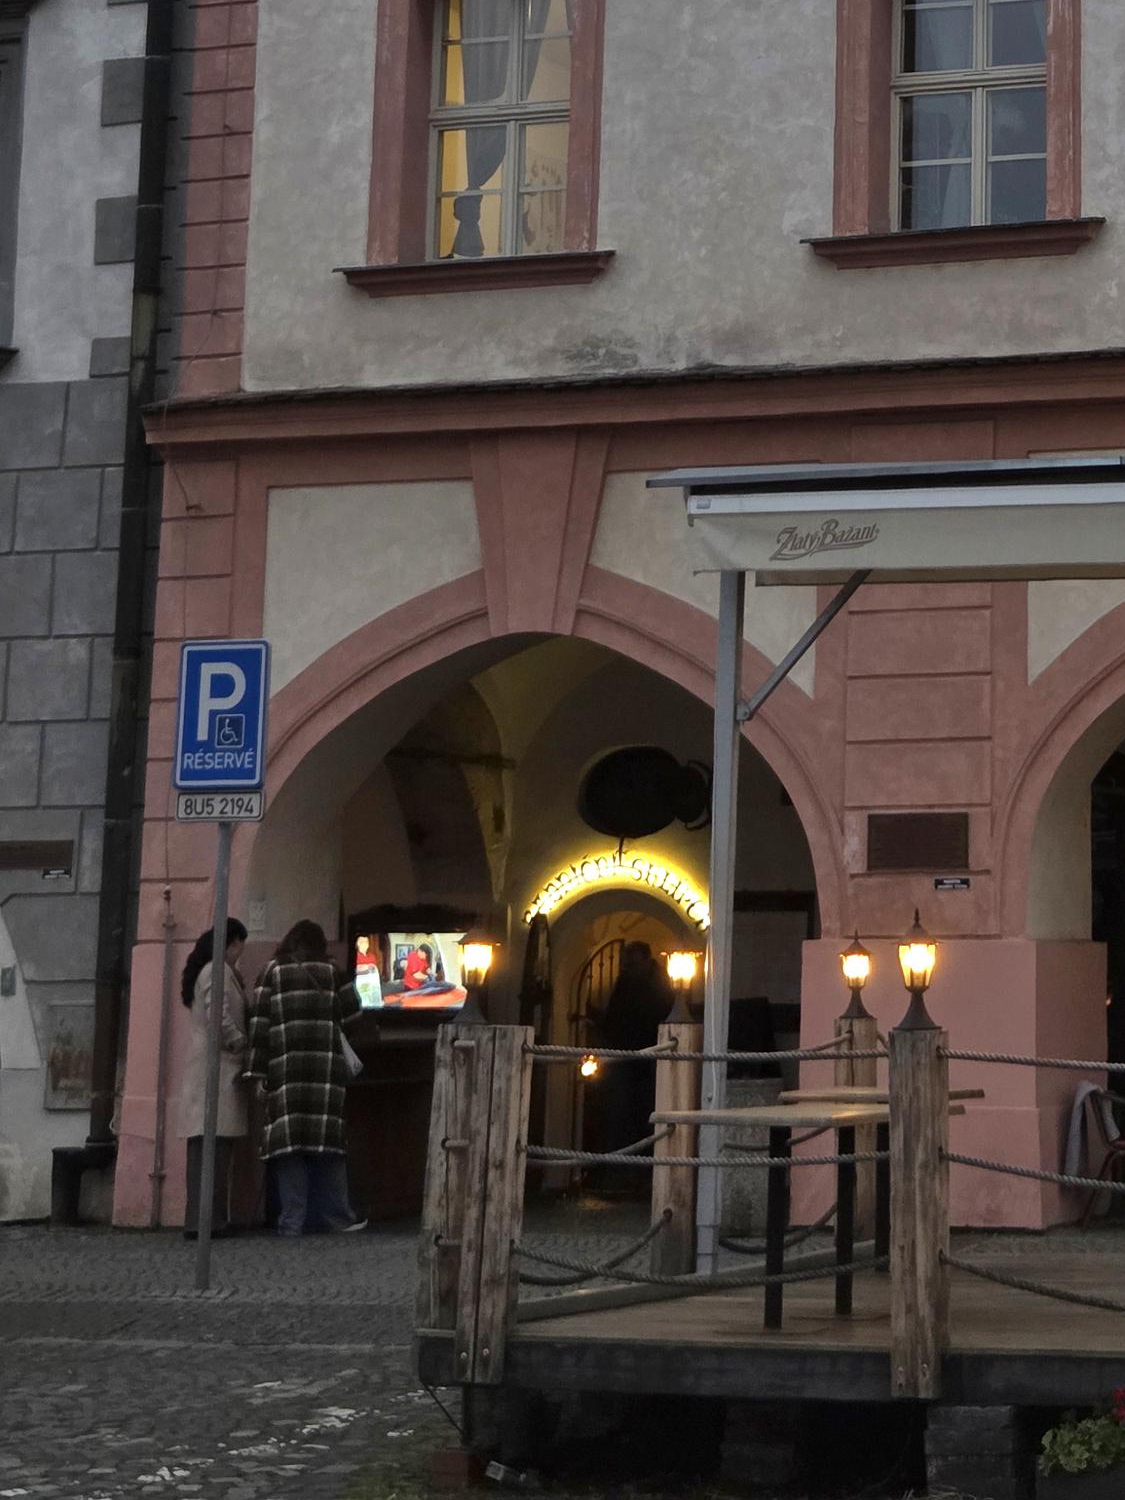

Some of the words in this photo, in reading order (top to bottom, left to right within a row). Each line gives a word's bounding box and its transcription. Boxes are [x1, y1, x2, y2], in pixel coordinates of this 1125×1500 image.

[197, 661, 246, 741] P
[183, 748, 254, 769] RÉSERVÉ
[184, 798, 215, 816] 8U5
[219, 797, 254, 815] 2194
